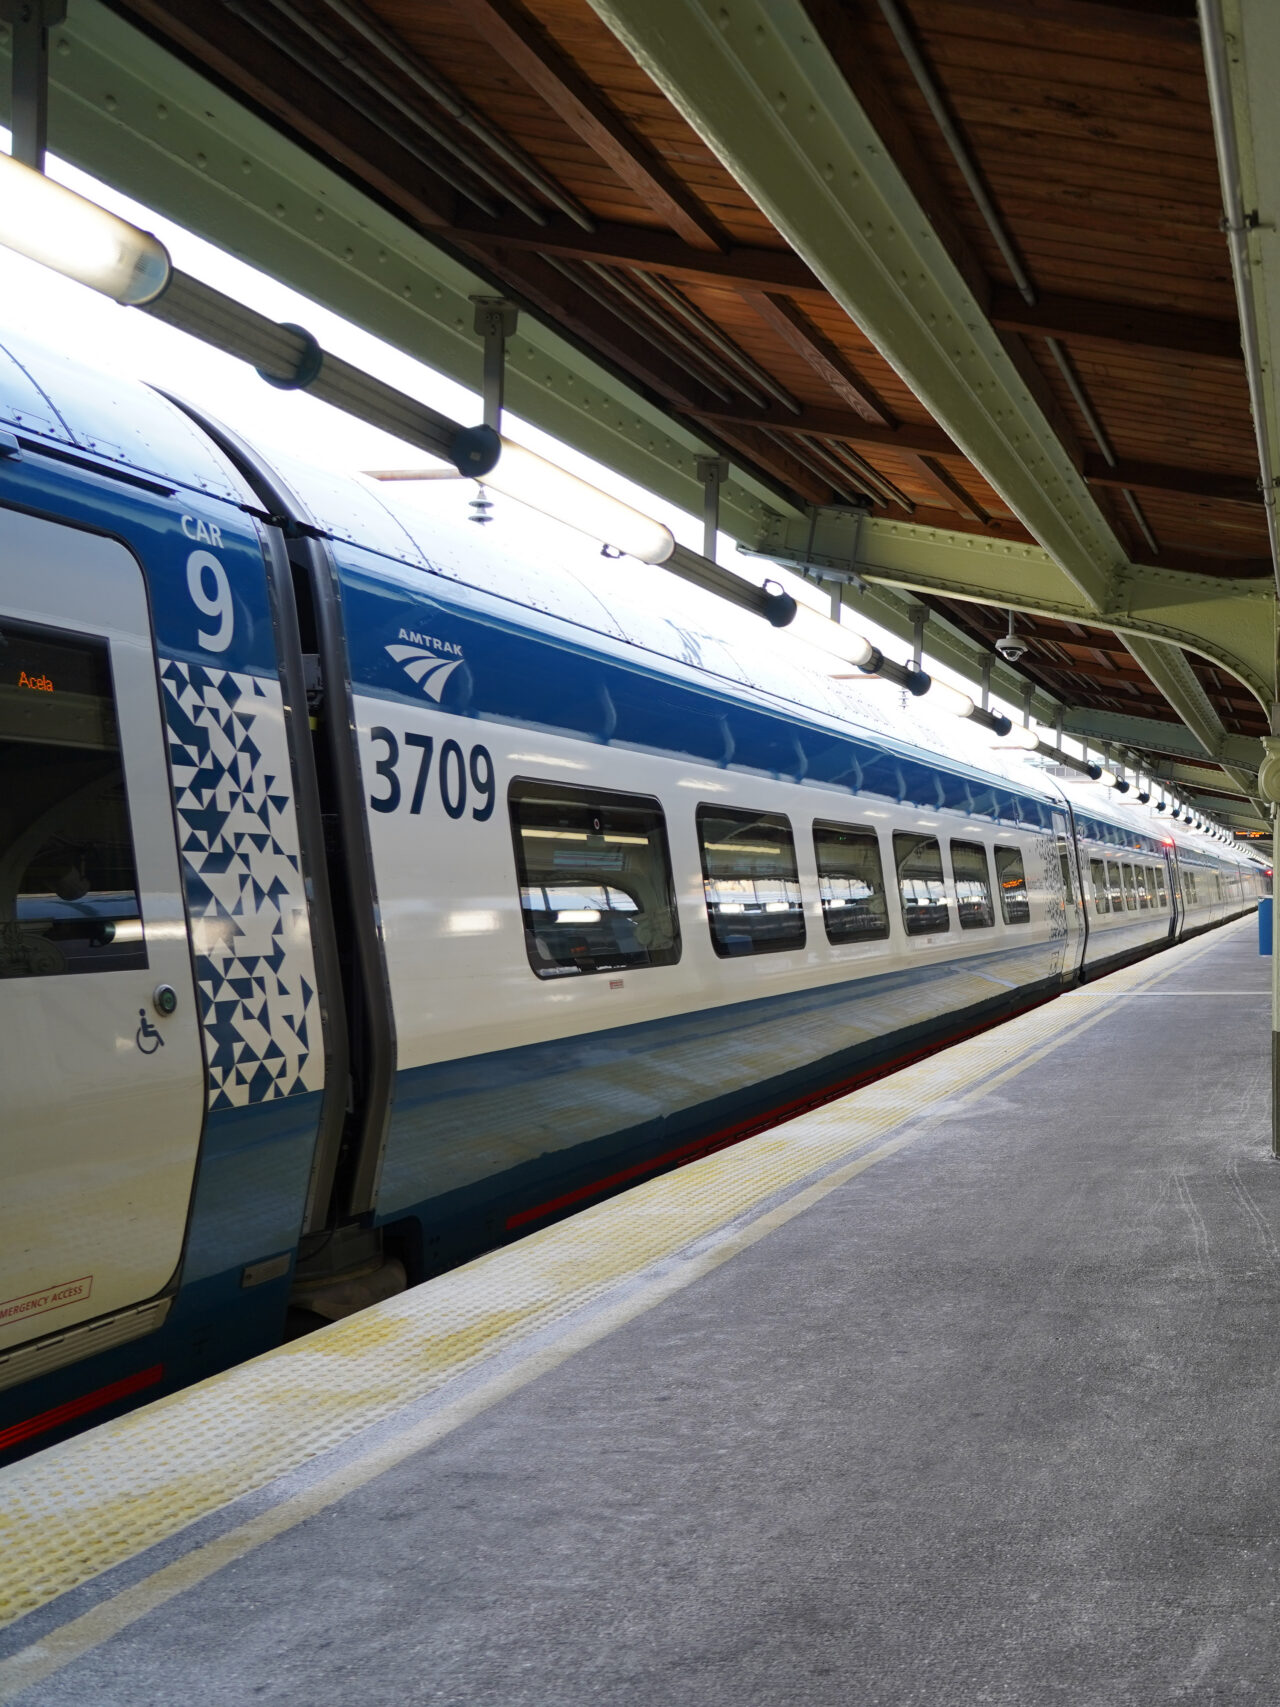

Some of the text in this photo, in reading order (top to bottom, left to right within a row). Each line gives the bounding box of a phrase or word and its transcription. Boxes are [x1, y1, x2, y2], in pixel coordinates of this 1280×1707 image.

[181, 515, 224, 548] CAR
[186, 550, 234, 652] 9
[398, 627, 463, 657] AMTRAK
[18, 671, 54, 691] Acela
[370, 726, 495, 822] 3709
[0, 1285, 83, 1318] MERGENCY ACCESS
